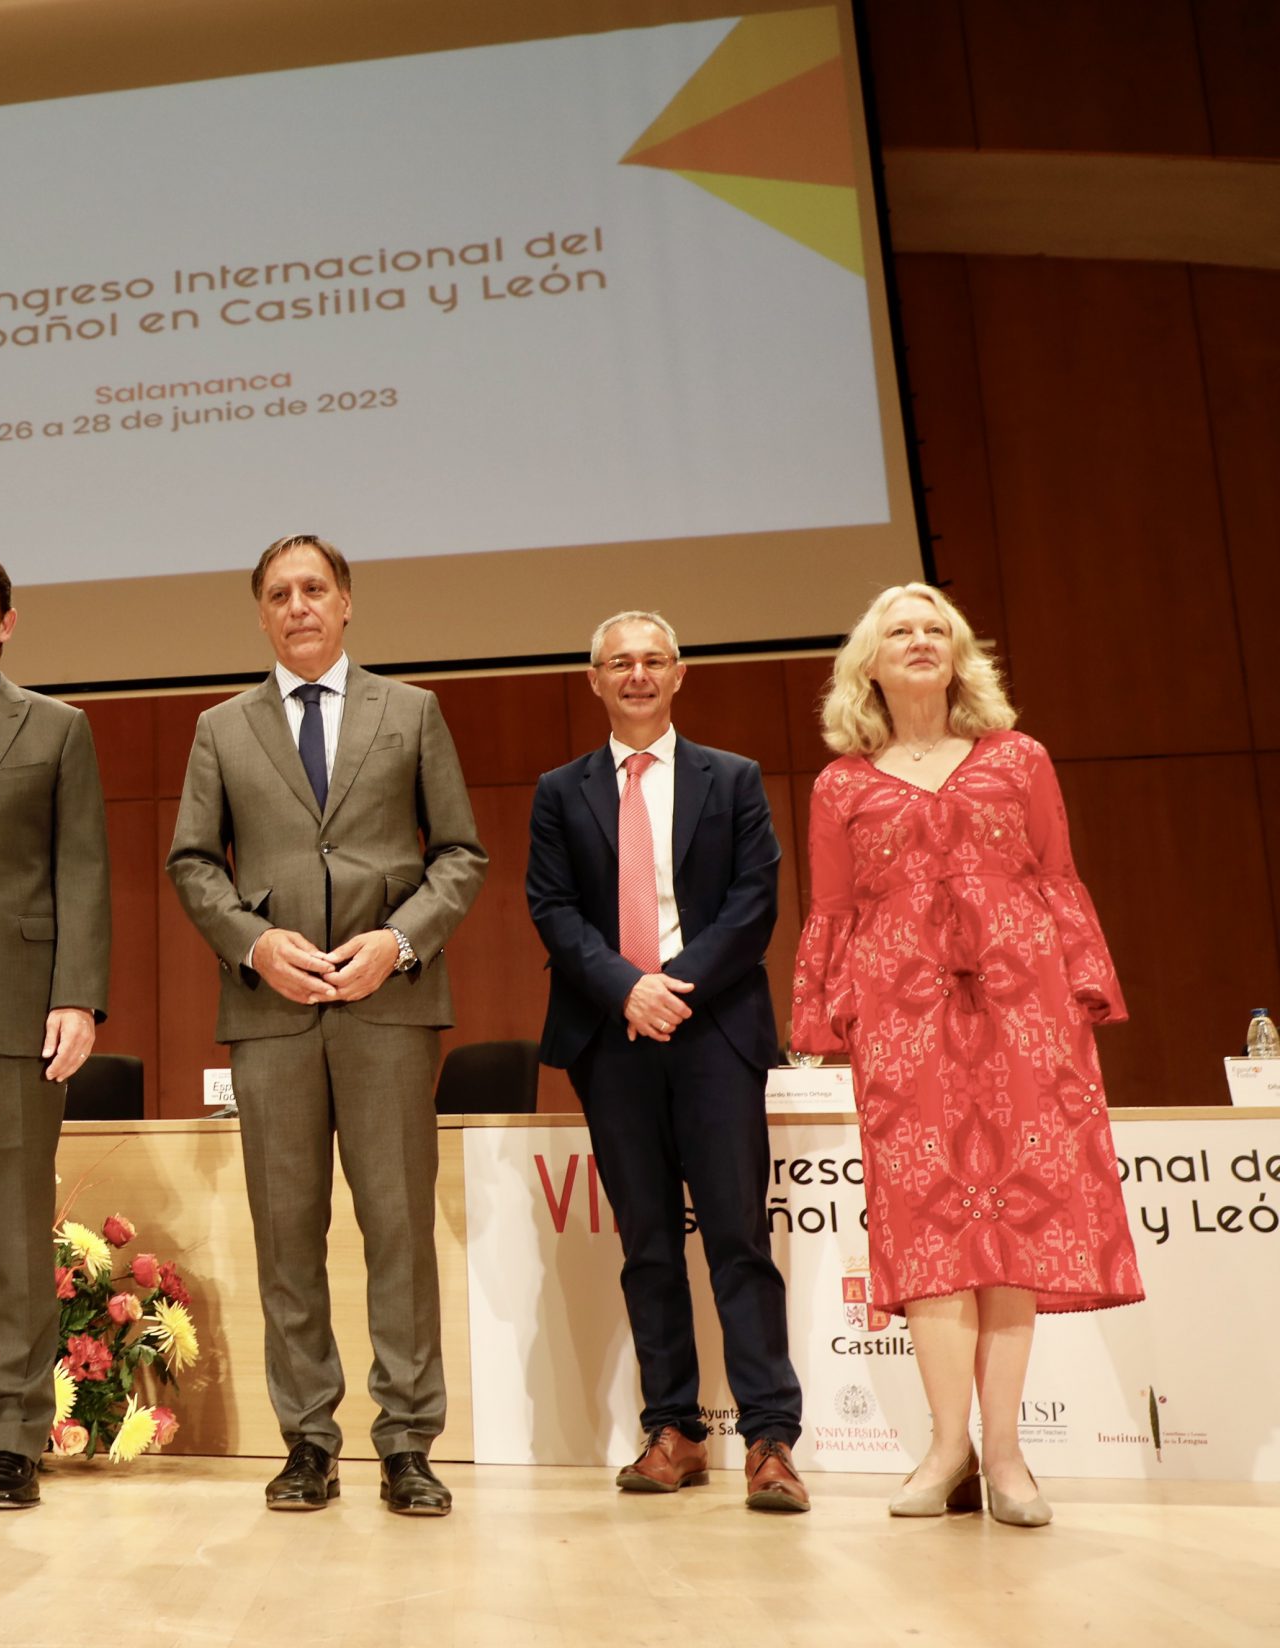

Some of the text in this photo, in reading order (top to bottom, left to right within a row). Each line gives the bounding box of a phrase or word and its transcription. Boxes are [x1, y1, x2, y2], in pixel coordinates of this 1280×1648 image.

[173, 236, 503, 295] Internacional
[524, 226, 603, 259] del
[138, 307, 200, 334] en
[219, 287, 407, 326] Castilla
[428, 283, 458, 314] y
[482, 263, 607, 300] León
[42, 420, 64, 438] a
[73, 414, 111, 436] 28
[120, 410, 163, 431] de
[171, 401, 255, 432] junio
[264, 397, 308, 418] de
[317, 387, 399, 414] 2023
[94, 371, 292, 405] Salamanca
[533, 1154, 620, 1234] VI
[1141, 1206, 1170, 1245] y
[1098, 1432, 1150, 1443] Instituto
